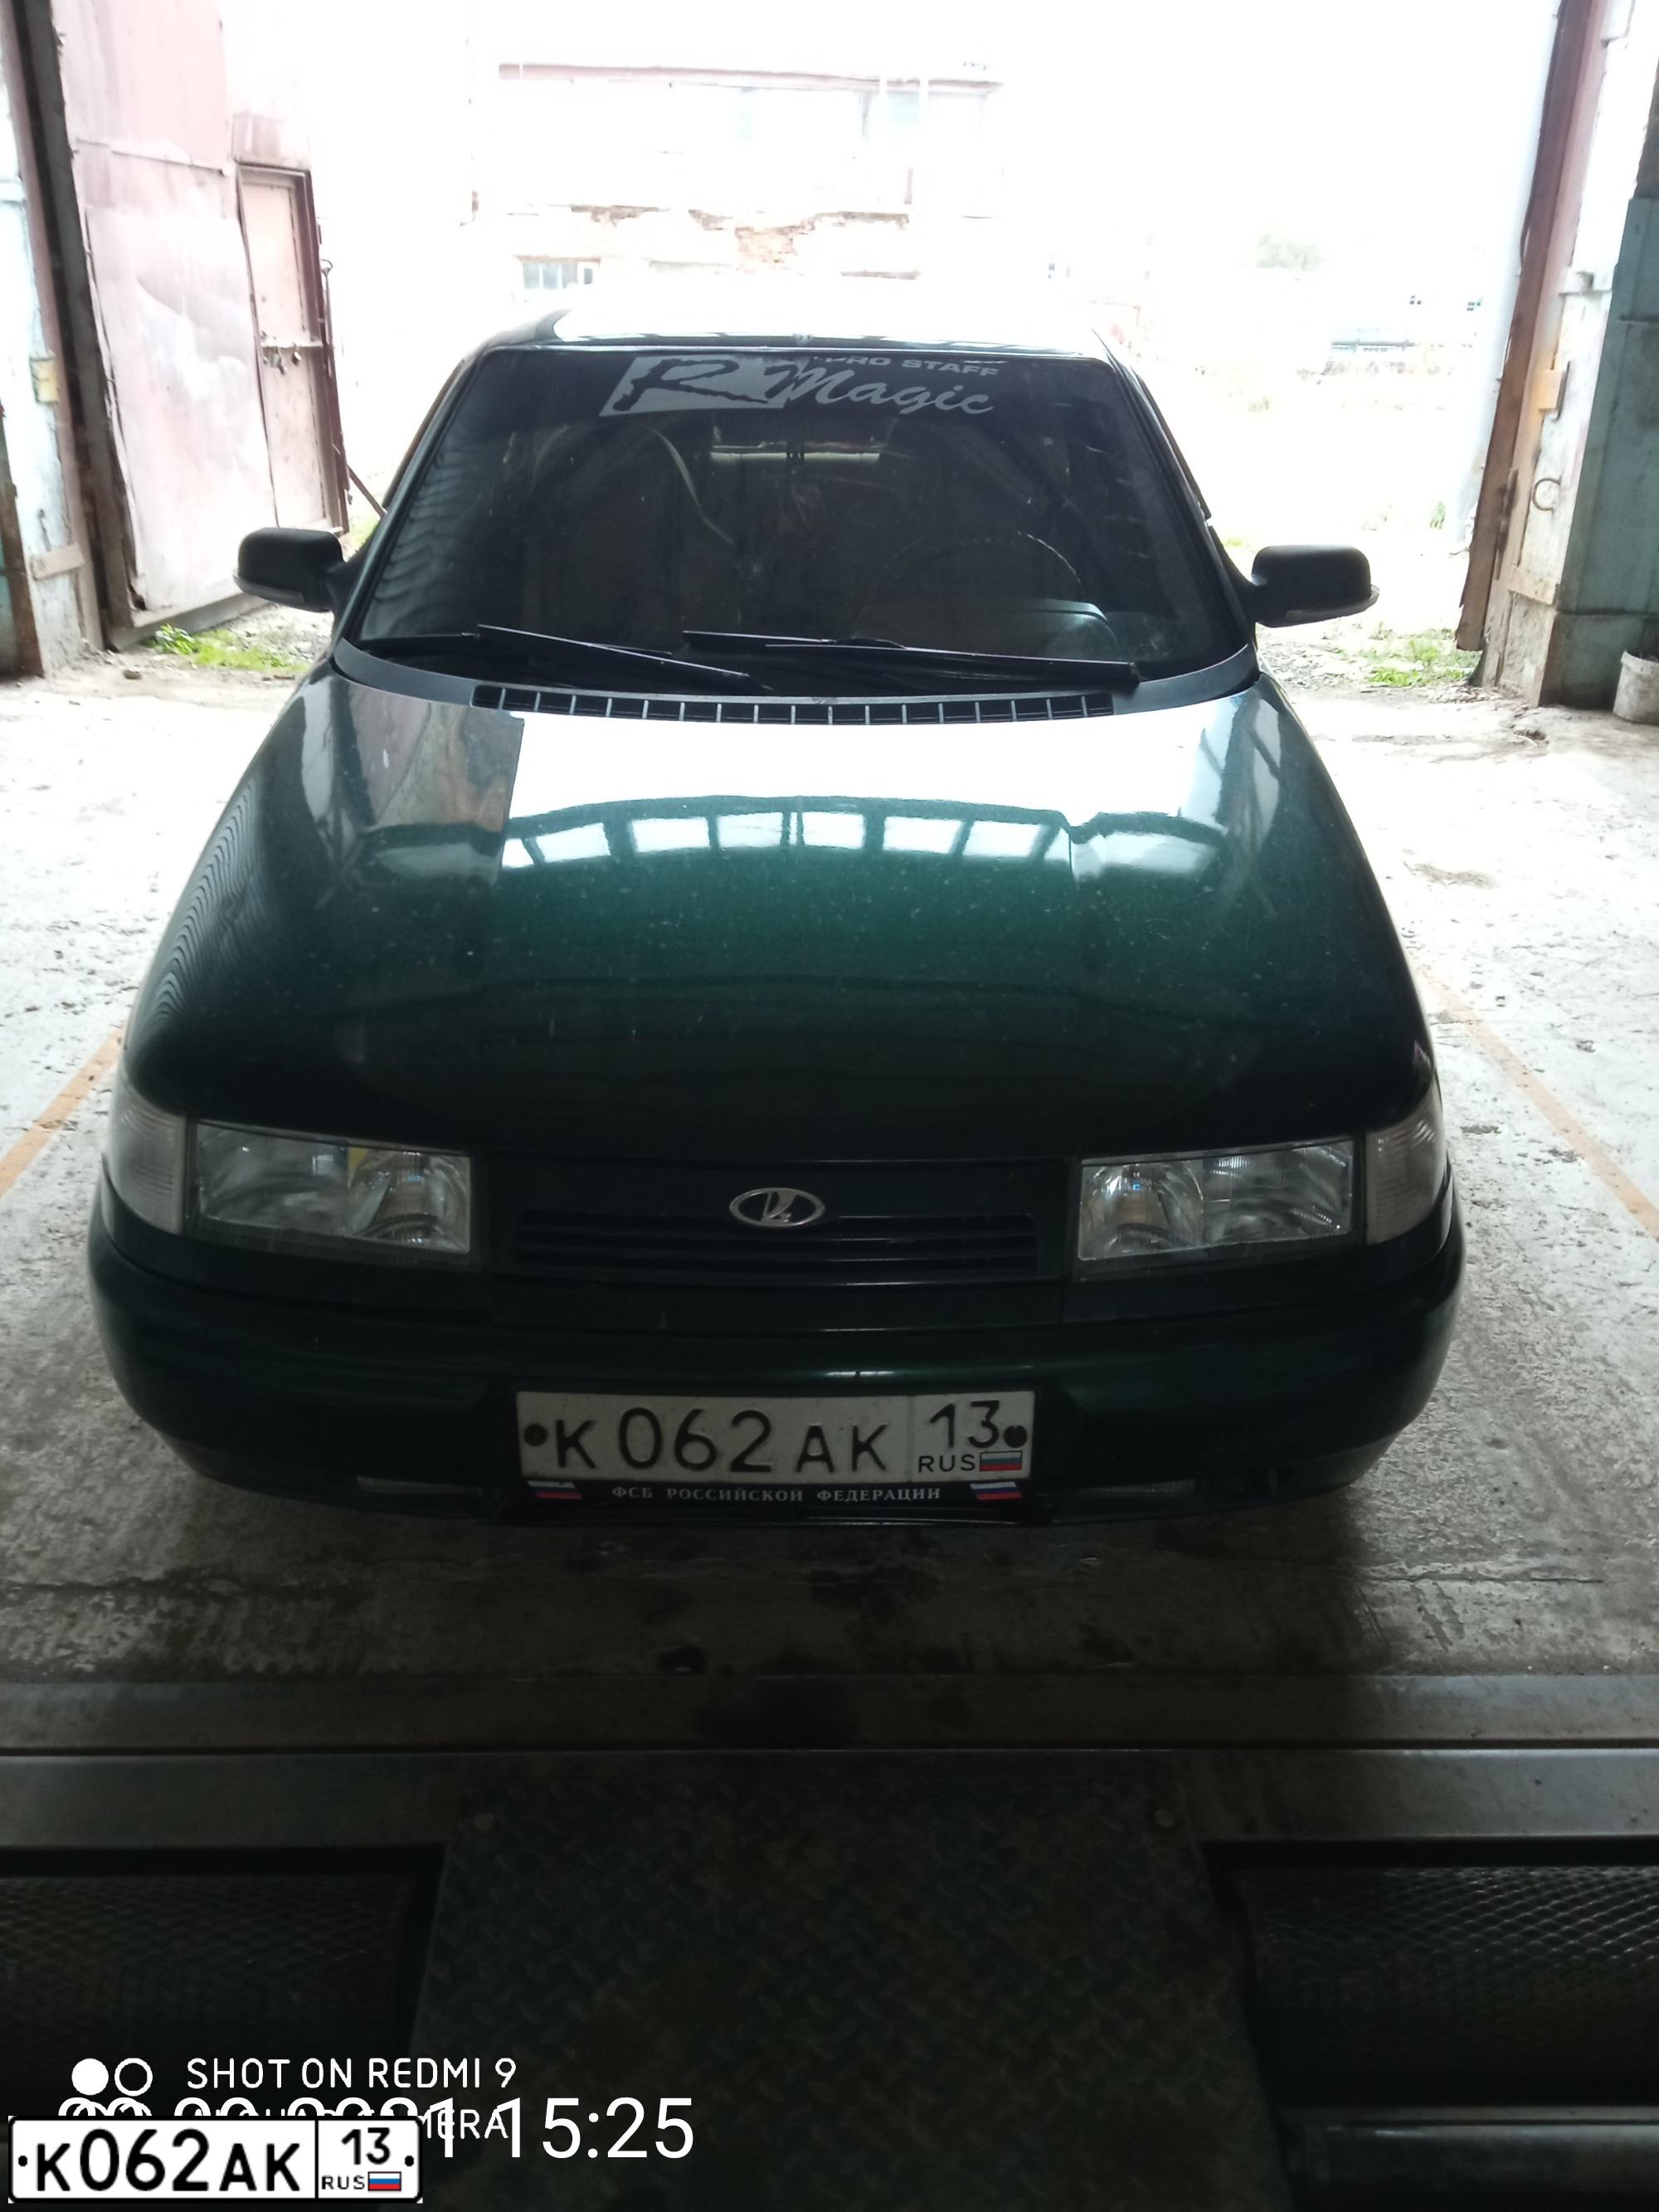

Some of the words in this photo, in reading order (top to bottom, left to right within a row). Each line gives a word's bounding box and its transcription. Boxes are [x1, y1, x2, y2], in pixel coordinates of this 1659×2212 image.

[902, 359, 999, 376] STAFF
[929, 1400, 1000, 1449] 13
[918, 1454, 975, 1473] RUS
[611, 1486, 654, 1499] ФСБ
[666, 1487, 803, 1502] РОССИЙСКОЙ
[816, 1488, 941, 1503] ФЕДЕРАЦИИ
